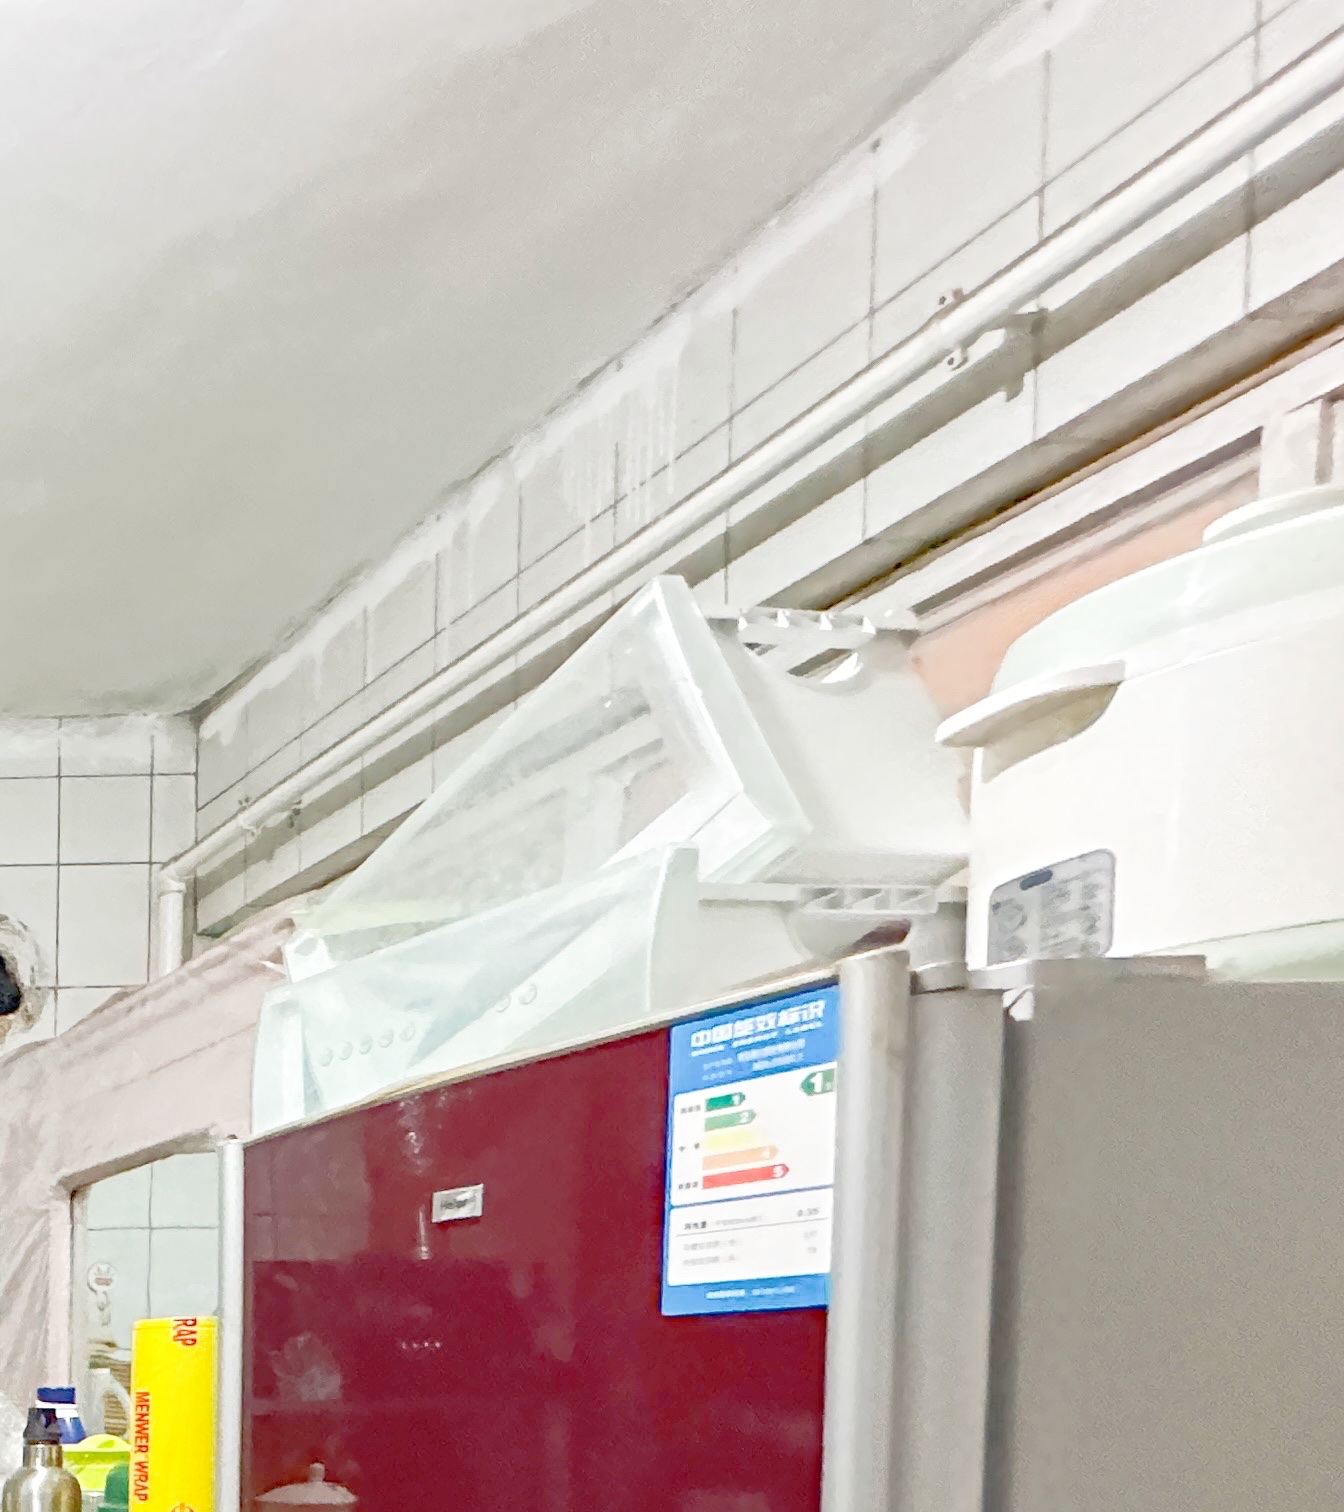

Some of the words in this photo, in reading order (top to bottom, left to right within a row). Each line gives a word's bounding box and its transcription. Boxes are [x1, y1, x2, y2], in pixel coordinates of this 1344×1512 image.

[739, 1111, 751, 1124] 2
[134, 1391, 150, 1454] MENWER
[133, 1460, 150, 1501] WRAP
